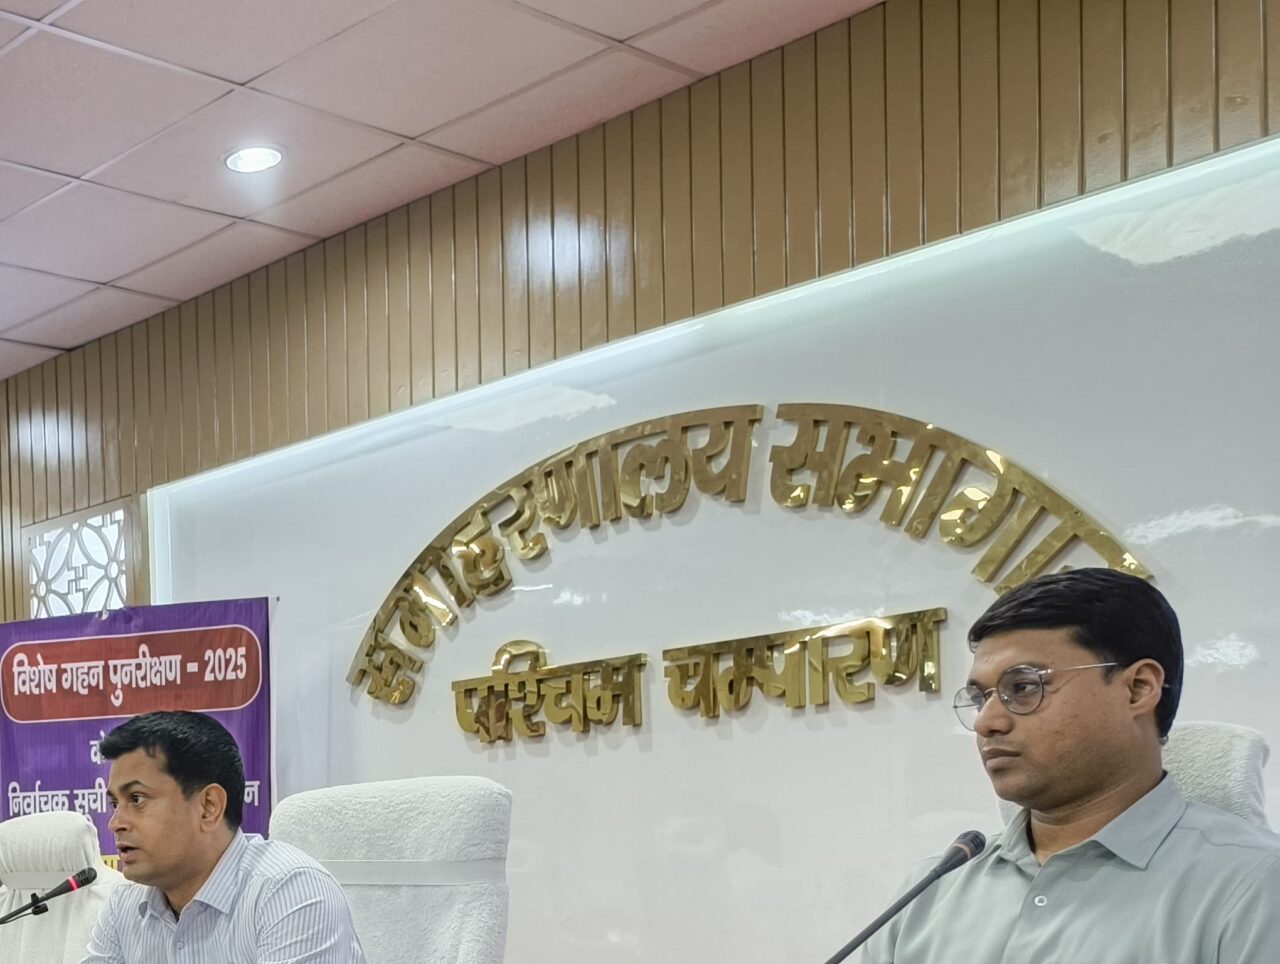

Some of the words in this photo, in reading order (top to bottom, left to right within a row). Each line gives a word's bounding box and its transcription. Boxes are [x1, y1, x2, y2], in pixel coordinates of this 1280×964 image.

[769, 403, 1156, 596] सभागा
[12, 652, 57, 696] विशेष
[61, 660, 105, 695] गहन
[108, 643, 182, 707] पुनरीक्षण
[204, 646, 247, 682] 2025
[662, 607, 948, 718] चम्पारण
[8, 781, 70, 816] निर्वाचक
